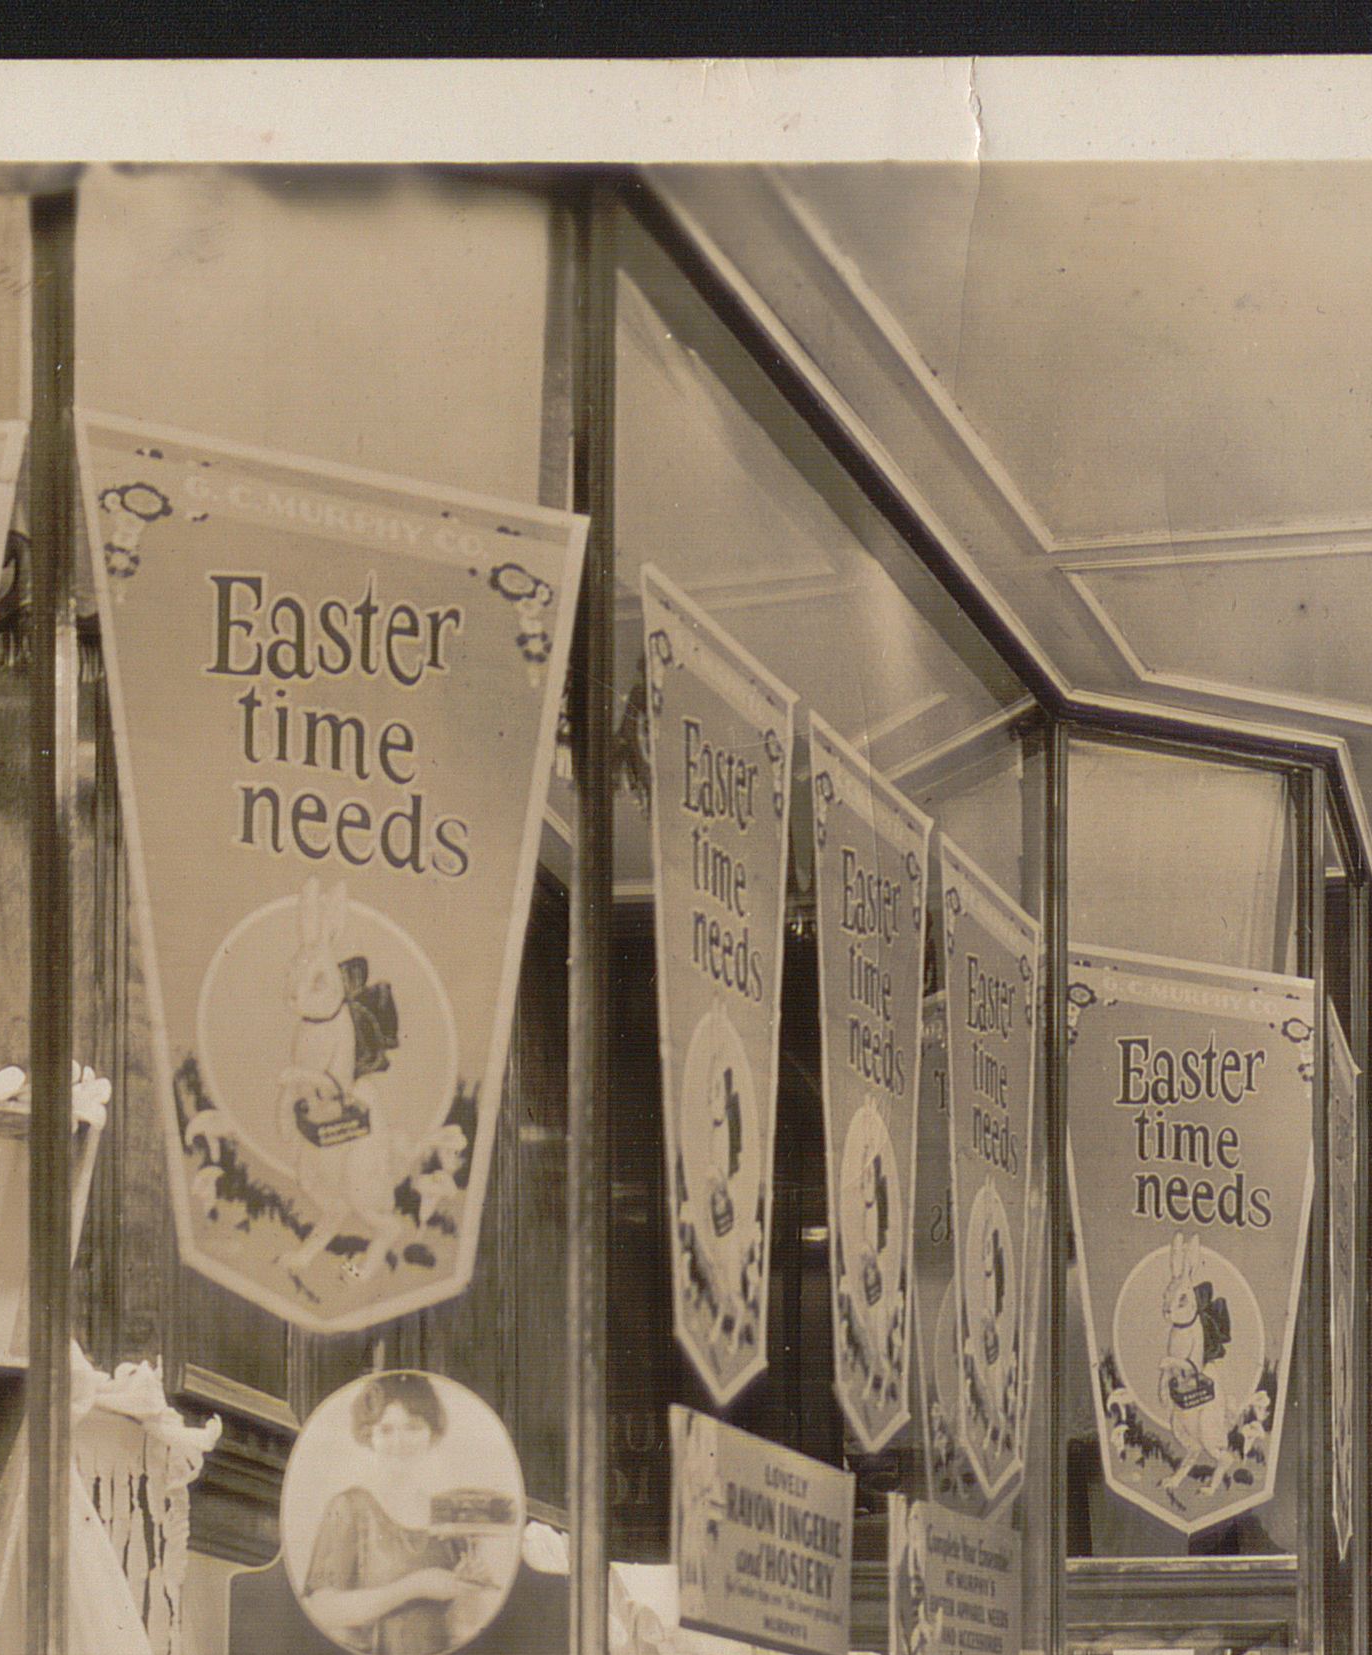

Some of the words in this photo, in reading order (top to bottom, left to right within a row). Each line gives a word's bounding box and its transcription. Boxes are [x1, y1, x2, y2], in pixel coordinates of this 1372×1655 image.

[265, 492, 427, 545] MURPHY
[205, 570, 463, 687] Easter
[237, 686, 417, 785] time
[681, 716, 759, 832] Easter
[239, 786, 470, 878] needs
[691, 826, 748, 919] time
[840, 849, 902, 946] Easter
[691, 908, 765, 1005] needs
[849, 942, 893, 1023] time
[965, 953, 1017, 1040] Easter
[849, 1014, 907, 1099] needs
[972, 1039, 1009, 1111] time
[1115, 1029, 1266, 1106] Easter
[972, 1103, 1019, 1179] needs
[1133, 1108, 1242, 1170] time
[1133, 1172, 1273, 1229] needs
[726, 1481, 776, 1533] RAYON
[778, 1501, 842, 1559] LINGERIE
[764, 1463, 808, 1498] LOVELY
[764, 1545, 836, 1600] HOSIERY
